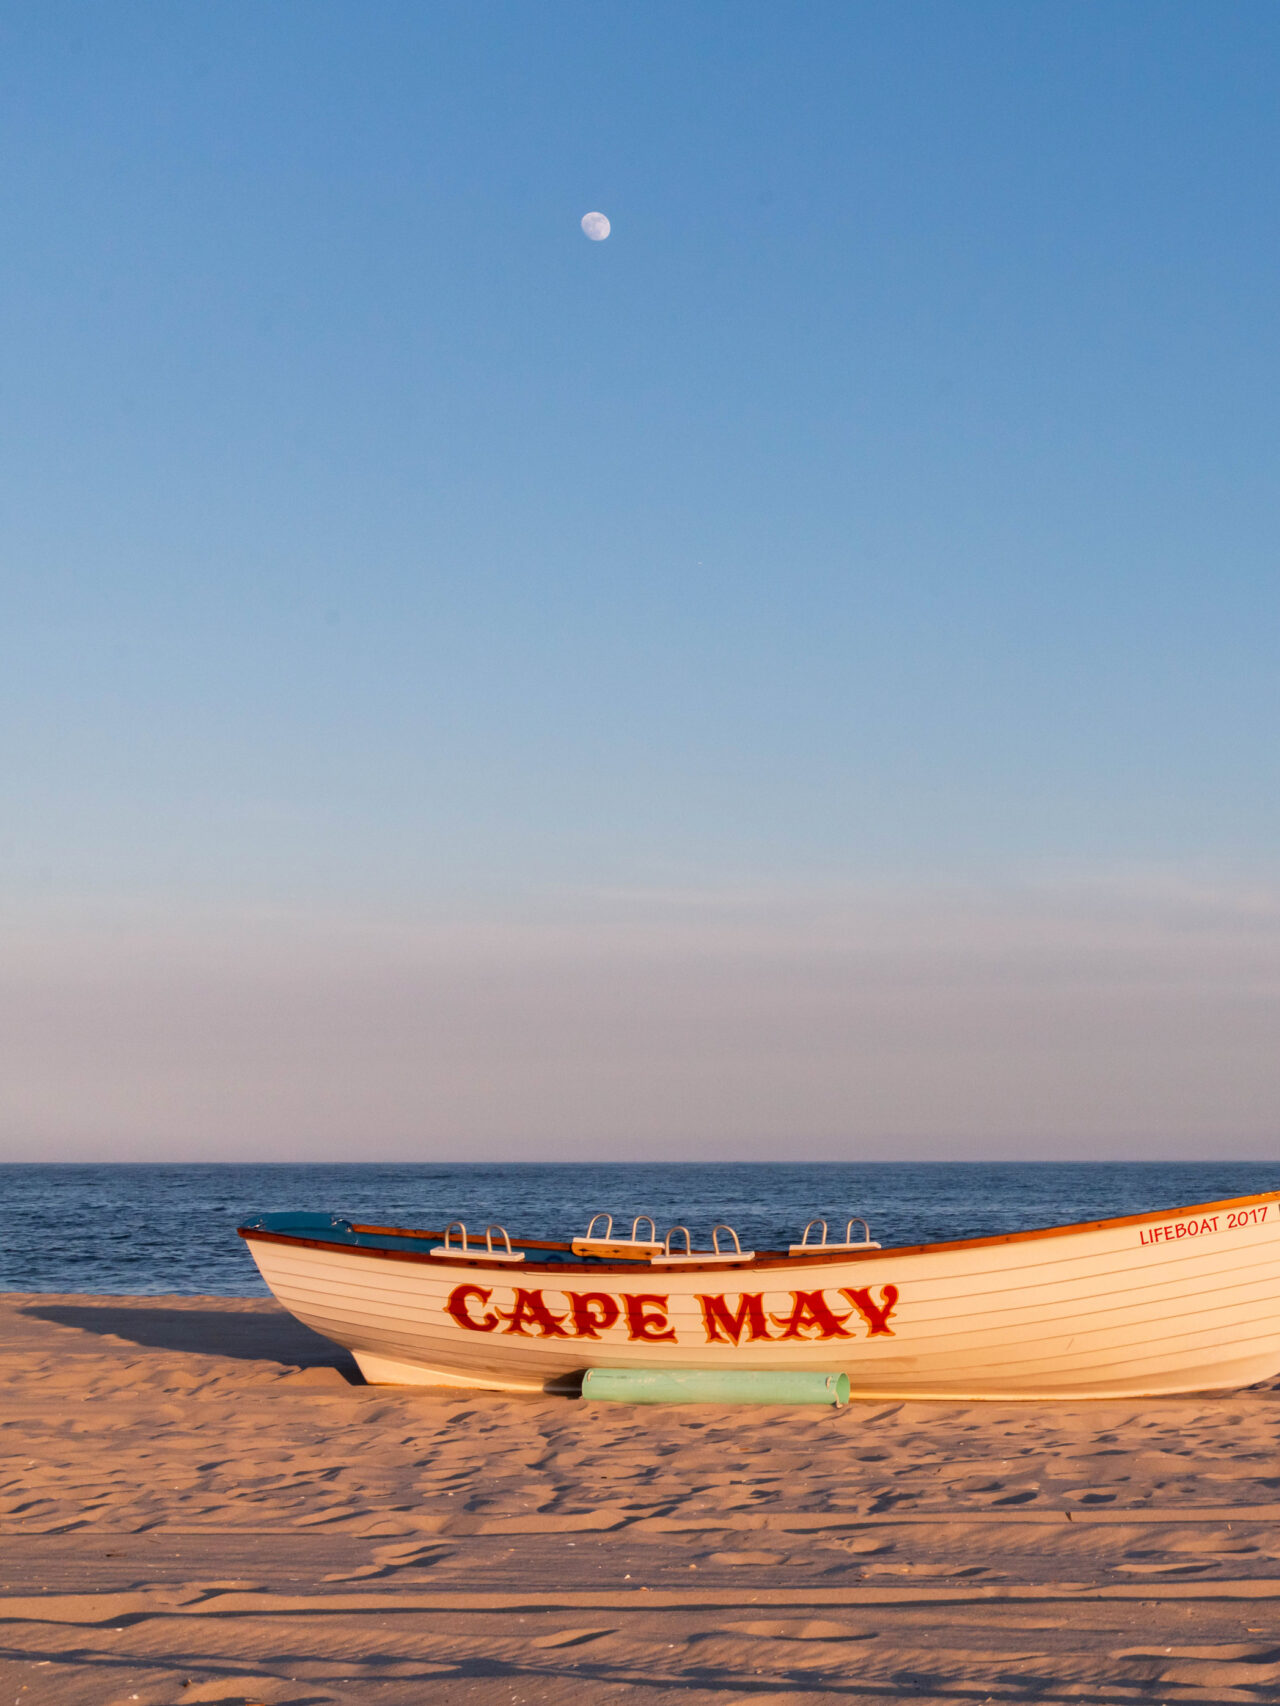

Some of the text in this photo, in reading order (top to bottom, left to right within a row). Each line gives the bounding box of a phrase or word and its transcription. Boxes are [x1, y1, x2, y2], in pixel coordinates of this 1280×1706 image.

[1139, 1206, 1269, 1245] LIFEBOAT 2017
[443, 1282, 901, 1348] CAPE MAY
